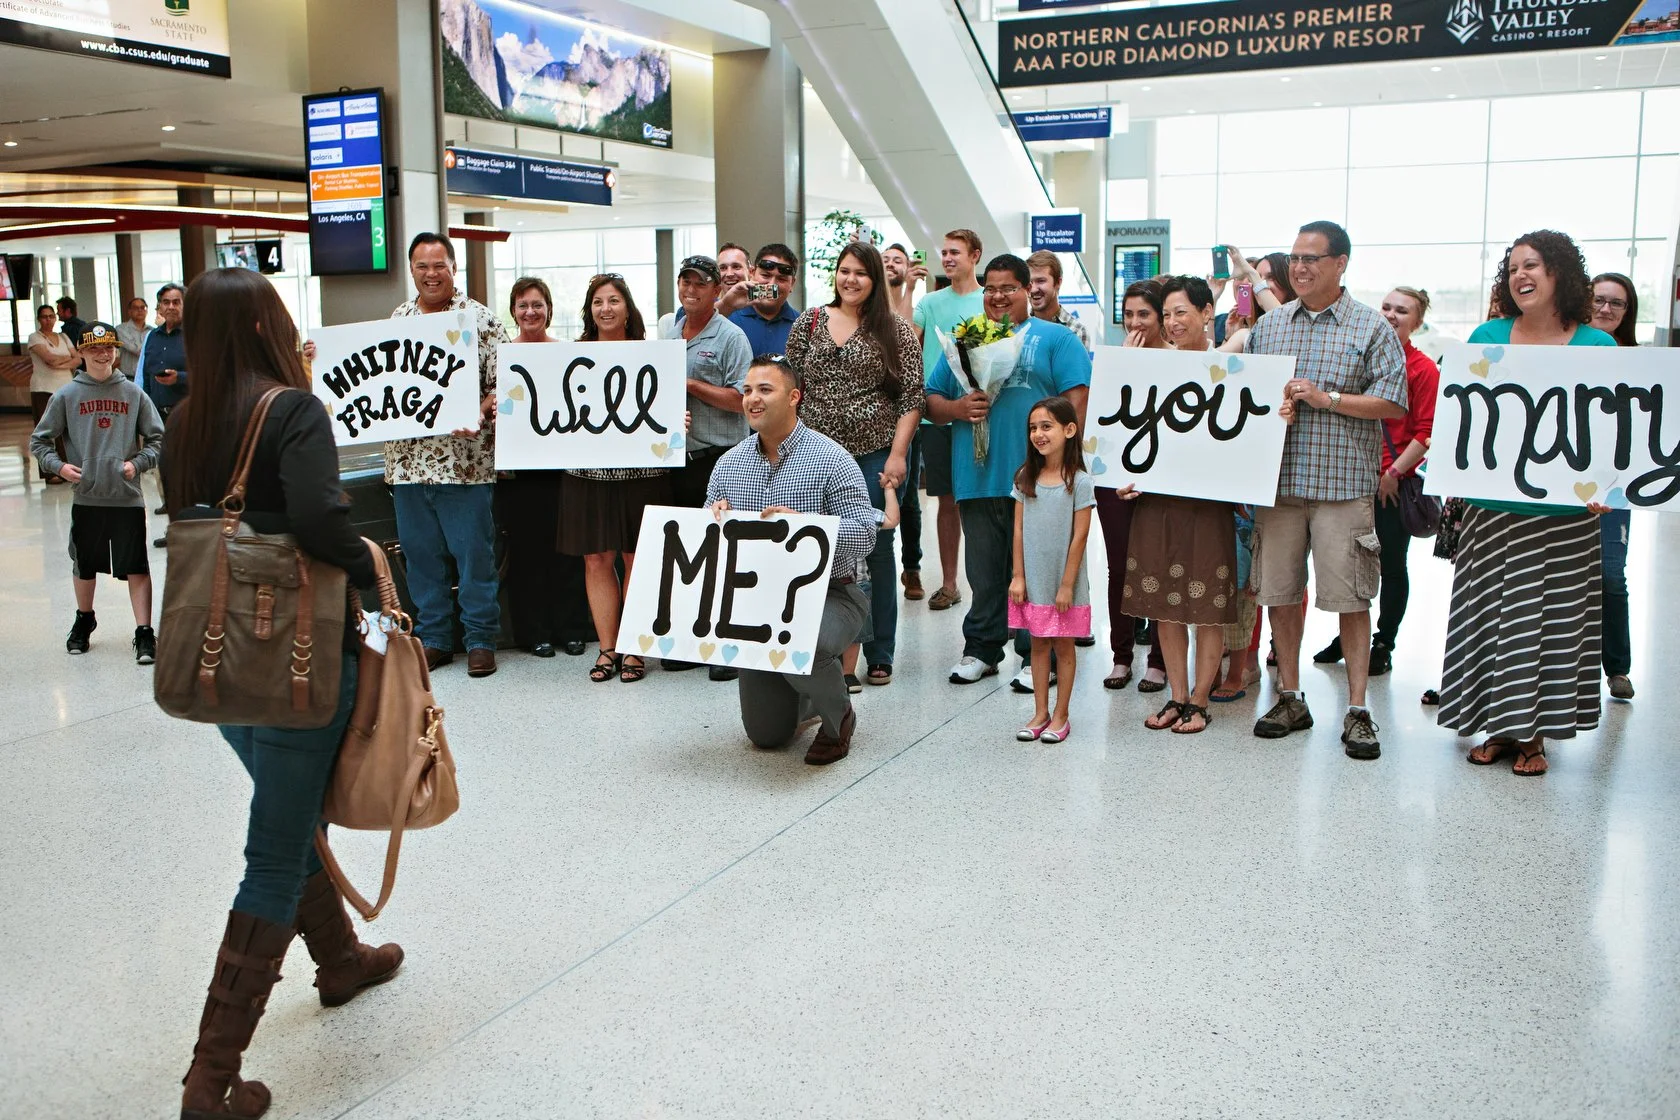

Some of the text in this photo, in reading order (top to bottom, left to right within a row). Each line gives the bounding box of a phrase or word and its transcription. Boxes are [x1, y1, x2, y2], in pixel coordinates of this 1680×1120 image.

[150, 17, 207, 35] SACRAMENTO
[1013, 3, 1393, 51] NORTHERN CALIFORNIA'S PREMIER
[1489, 8, 1574, 32] VALLEY
[165, 30, 194, 41] STATE
[1491, 27, 1591, 42] CASINO RESORT
[80, 40, 209, 68] www.cba.csus.edu/graduate
[1013, 24, 1425, 73] AAA FOUR DIAMOND LUXURY RESORT
[1025, 115, 1034, 123] Up
[1035, 113, 1062, 121] Escalator
[1070, 111, 1097, 121] Ticketing
[313, 153, 333, 161] volaris
[466, 156, 489, 167] Baggage
[490, 159, 505, 168] Claim
[530, 164, 544, 173] Public
[586, 171, 604, 180] Shuttles
[318, 212, 366, 224] Los Angeles, CA
[374, 226, 384, 247] 3
[1036, 229, 1075, 238] Up Escalator
[1107, 226, 1169, 237] INFORMATION
[1044, 237, 1073, 245] Ticketing
[267, 246, 279, 266] 4
[323, 339, 465, 399] WHITNEY
[510, 356, 667, 437] Will
[80, 399, 129, 415] AUBURN
[336, 385, 444, 438] FRAGA
[1098, 381, 1271, 474] you
[652, 518, 830, 645] ME?
